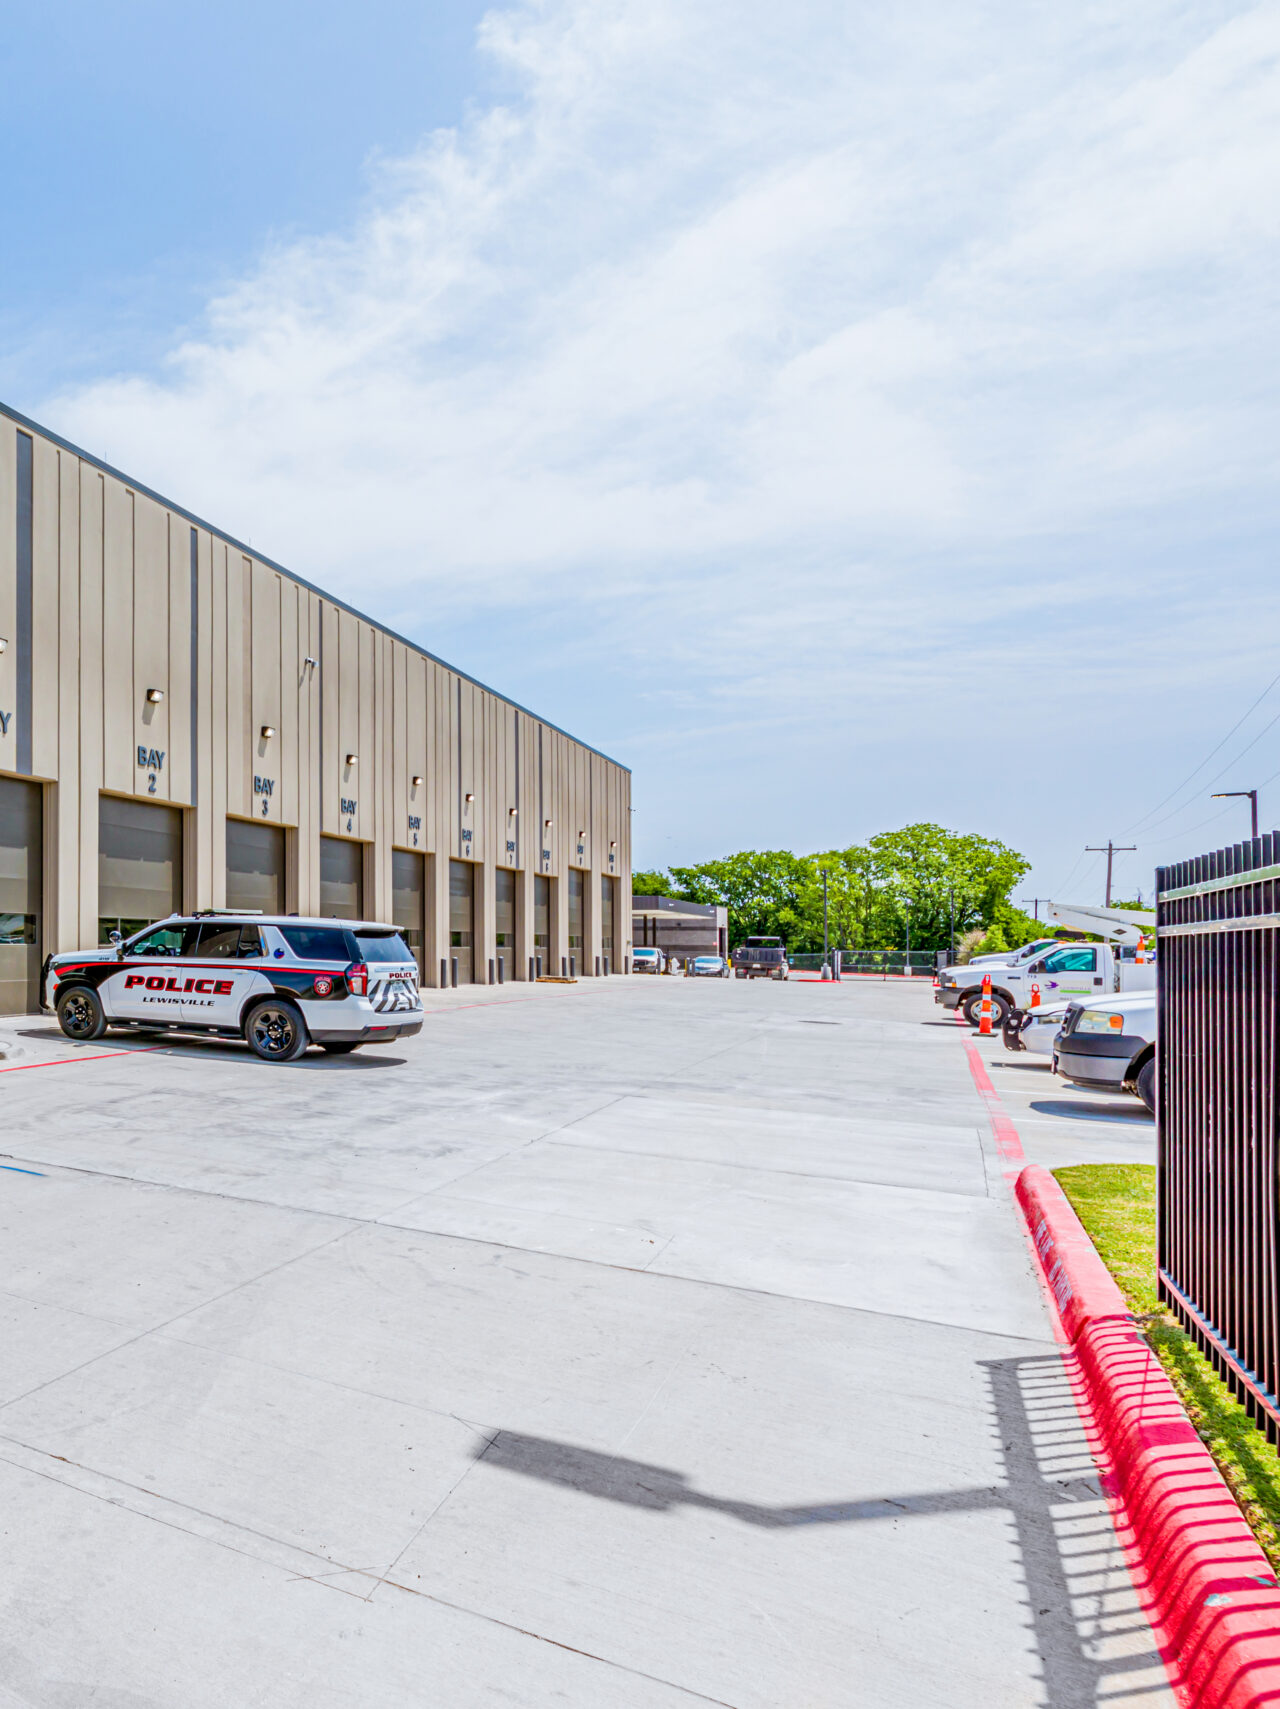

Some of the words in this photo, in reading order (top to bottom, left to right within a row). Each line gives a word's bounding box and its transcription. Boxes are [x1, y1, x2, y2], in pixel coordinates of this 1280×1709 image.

[137, 745, 165, 769] BAY
[148, 773, 157, 793] 2
[254, 775, 275, 796] BAY
[262, 799, 269, 815] 3
[341, 798, 357, 815] BAY
[347, 818, 352, 832] 4
[408, 815, 421, 830] BAY
[124, 975, 234, 995] POLICE
[142, 997, 215, 1007] LEWISVILLE
